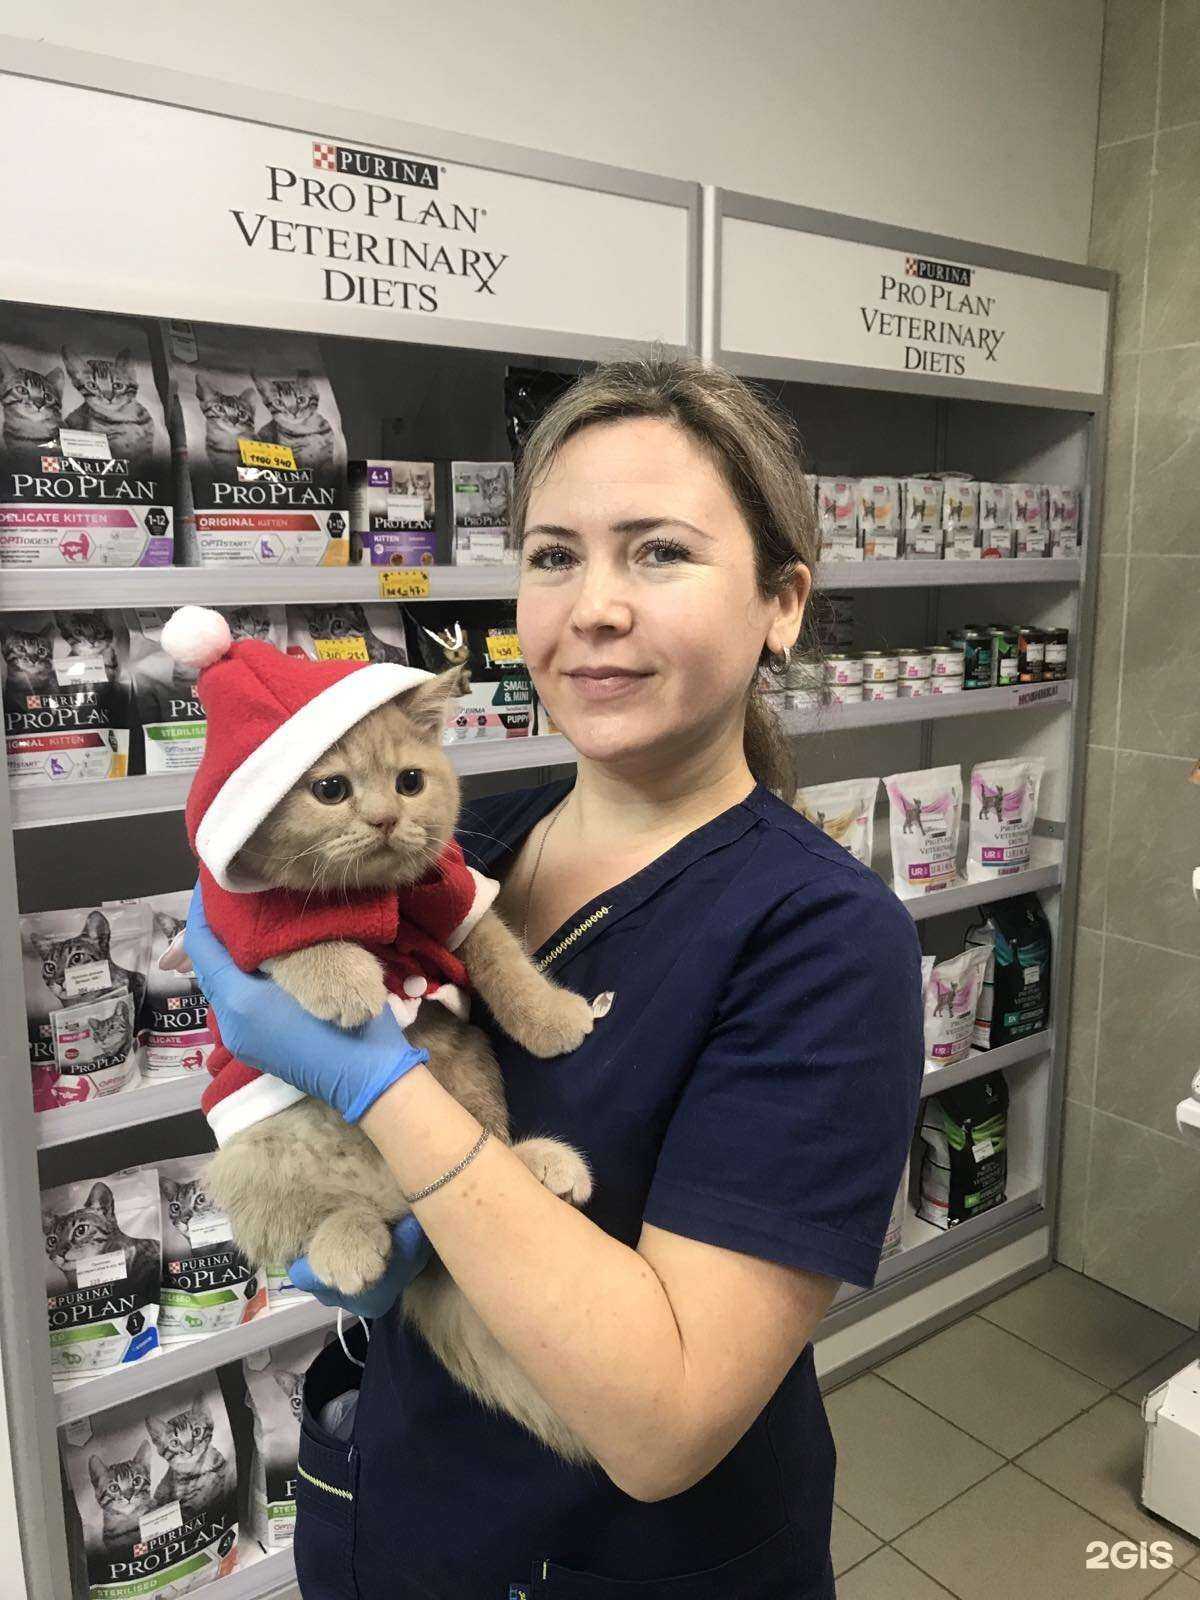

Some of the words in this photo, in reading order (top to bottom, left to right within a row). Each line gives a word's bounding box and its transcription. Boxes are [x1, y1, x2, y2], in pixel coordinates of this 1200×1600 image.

[341, 150, 435, 187] PURINA
[265, 165, 356, 213] PRO
[363, 183, 480, 234] PLAN
[228, 209, 510, 296] VETERINARY
[919, 262, 969, 285] PURINA
[320, 268, 438, 312] DIETS
[880, 274, 926, 306] PRO
[930, 284, 992, 317] PLAN
[860, 307, 1006, 362] VETERINARY
[904, 346, 966, 376] DIETS
[11, 474, 74, 498] PRO
[77, 476, 158, 500] PLAN
[212, 483, 266, 504] PRO
[269, 484, 336, 505] PLAN
[63, 513, 107, 523] KITTEN
[199, 517, 255, 527] ORIGINAL
[503, 680, 529, 691] SMALL
[504, 693, 512, 702] &
[513, 691, 529, 701] MINI
[6, 711, 54, 731] PRO
[507, 715, 529, 724] PUPPY
[151, 1010, 192, 1029] PRO
[183, 1255, 230, 1272] PURINA
[194, 1265, 252, 1289] PLAN
[58, 1287, 111, 1307] PURINA
[70, 1294, 138, 1323] PLAN
[150, 1517, 203, 1551] PURINA
[109, 1554, 161, 1581] PRO
[164, 1516, 226, 1565] PLAN
